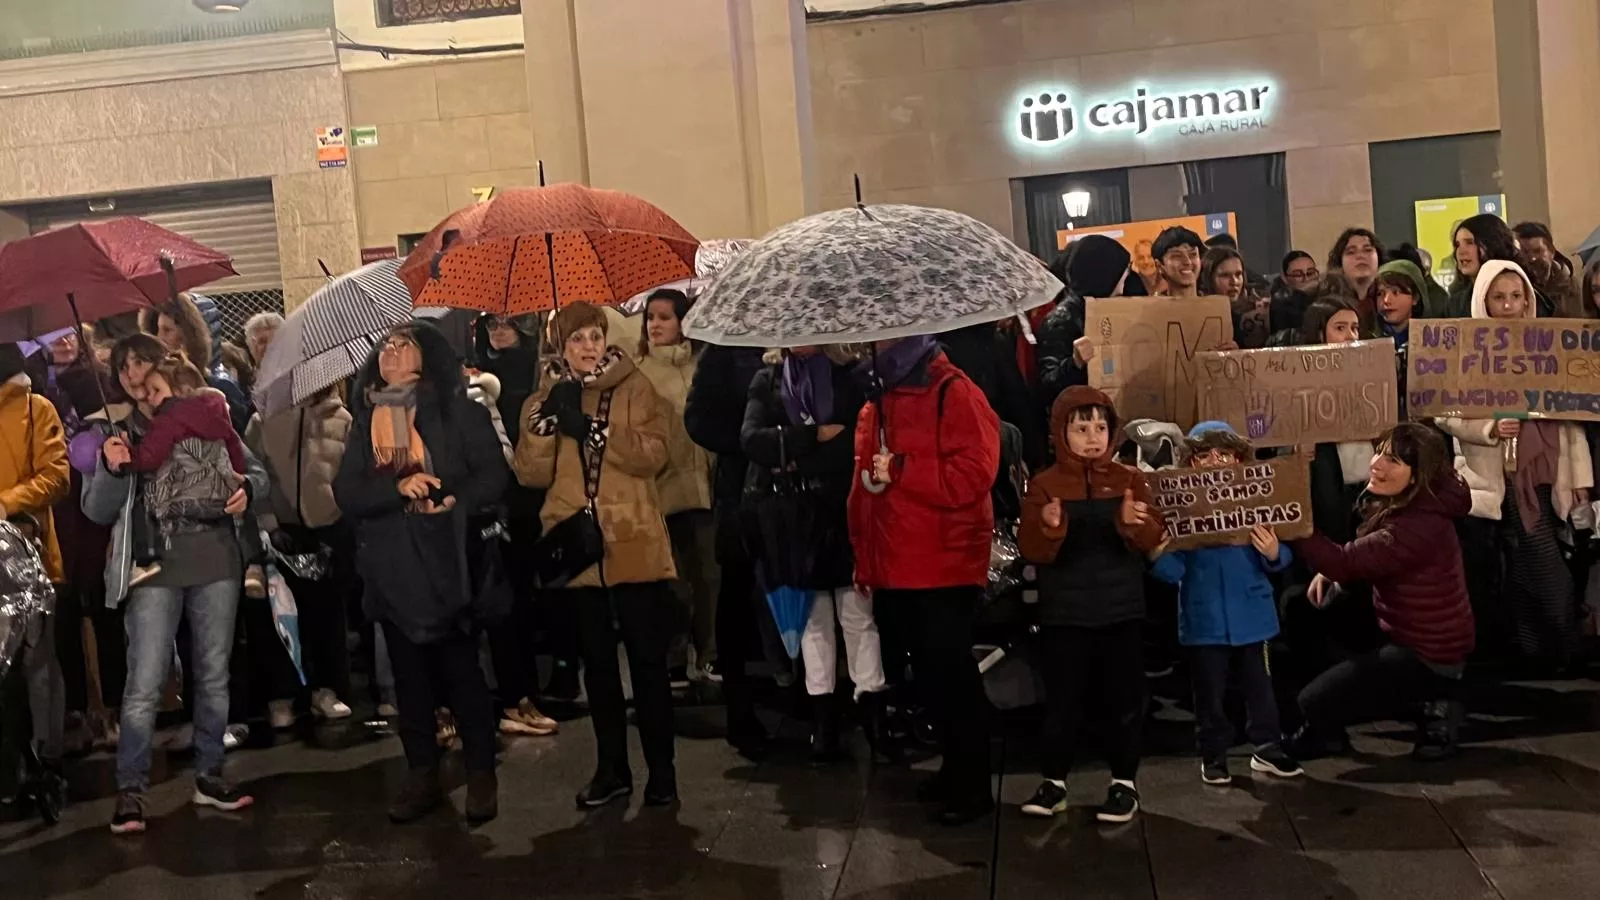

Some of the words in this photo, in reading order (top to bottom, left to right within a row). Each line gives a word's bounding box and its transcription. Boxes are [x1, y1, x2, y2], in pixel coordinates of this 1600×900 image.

[1088, 87, 1268, 135] cajamar
[1178, 123, 1215, 137] CAJA
[1220, 118, 1268, 133] RURAL
[1473, 326, 1509, 350] ES
[1523, 325, 1554, 352] UN
[1205, 354, 1257, 383] POR
[1301, 352, 1345, 373] POR
[1462, 347, 1559, 375] FIESTA
[1441, 389, 1520, 407] LUCHA
[1524, 390, 1539, 410] Y
[1159, 469, 1235, 491] HOMBRES
[1244, 463, 1275, 480] DEL
